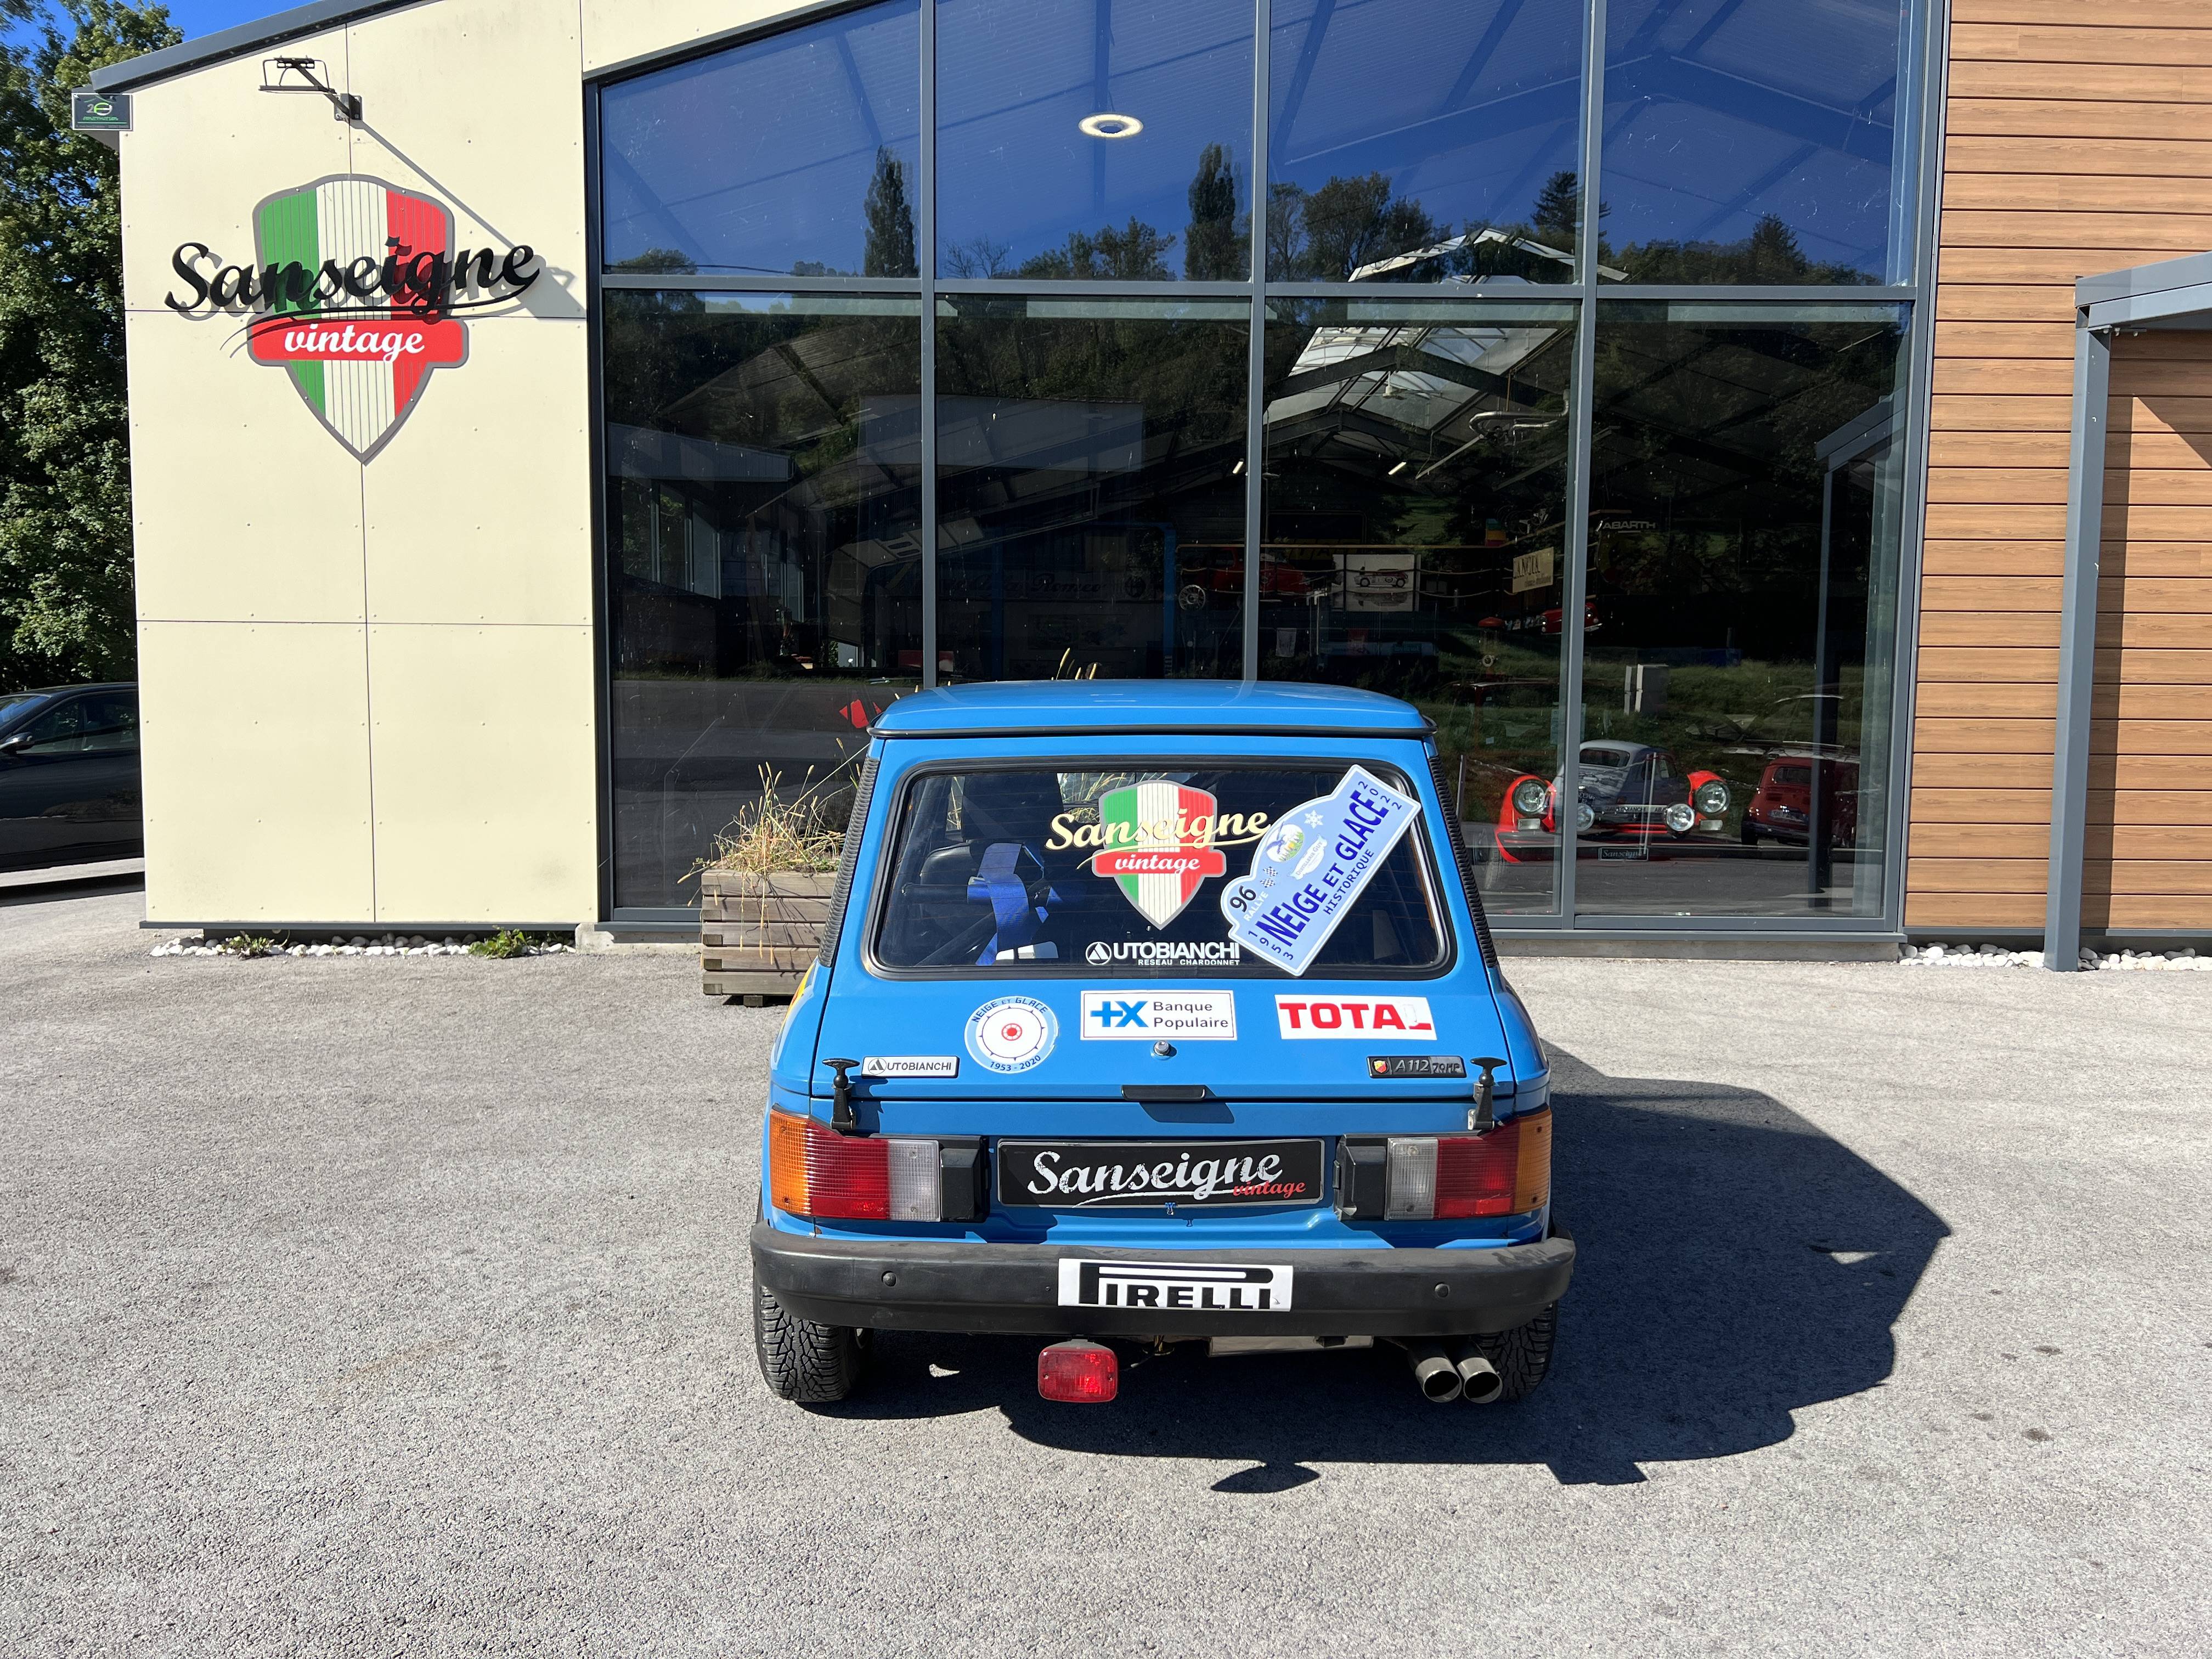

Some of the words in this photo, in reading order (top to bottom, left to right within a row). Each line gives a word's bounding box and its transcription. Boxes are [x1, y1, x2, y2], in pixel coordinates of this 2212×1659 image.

[165, 236, 540, 315] Sanseigne
[284, 324, 425, 362] vintage
[1602, 521, 1656, 529] ABARTH
[1044, 808, 1272, 850] Sanseigne
[1114, 854, 1201, 874] vintage
[1255, 883, 1328, 947] NEIGE
[1321, 862, 1345, 888] ET
[1335, 789, 1390, 861] GLACE
[1323, 849, 1374, 915] HISTORIQUE
[1229, 885, 1257, 913] 96
[1243, 890, 1269, 922] RALLYE
[972, 1001, 998, 1023] NEIGE
[1015, 997, 1048, 1014] GLACE
[1153, 1001, 1213, 1013] Banque
[1153, 1017, 1229, 1030] Populaire
[1395, 1059, 1430, 1073] A112
[1028, 1150, 1284, 1200] Sanseigne
[1233, 1180, 1306, 1199] vintage
[1079, 1262, 1274, 1310] PIRELLI
